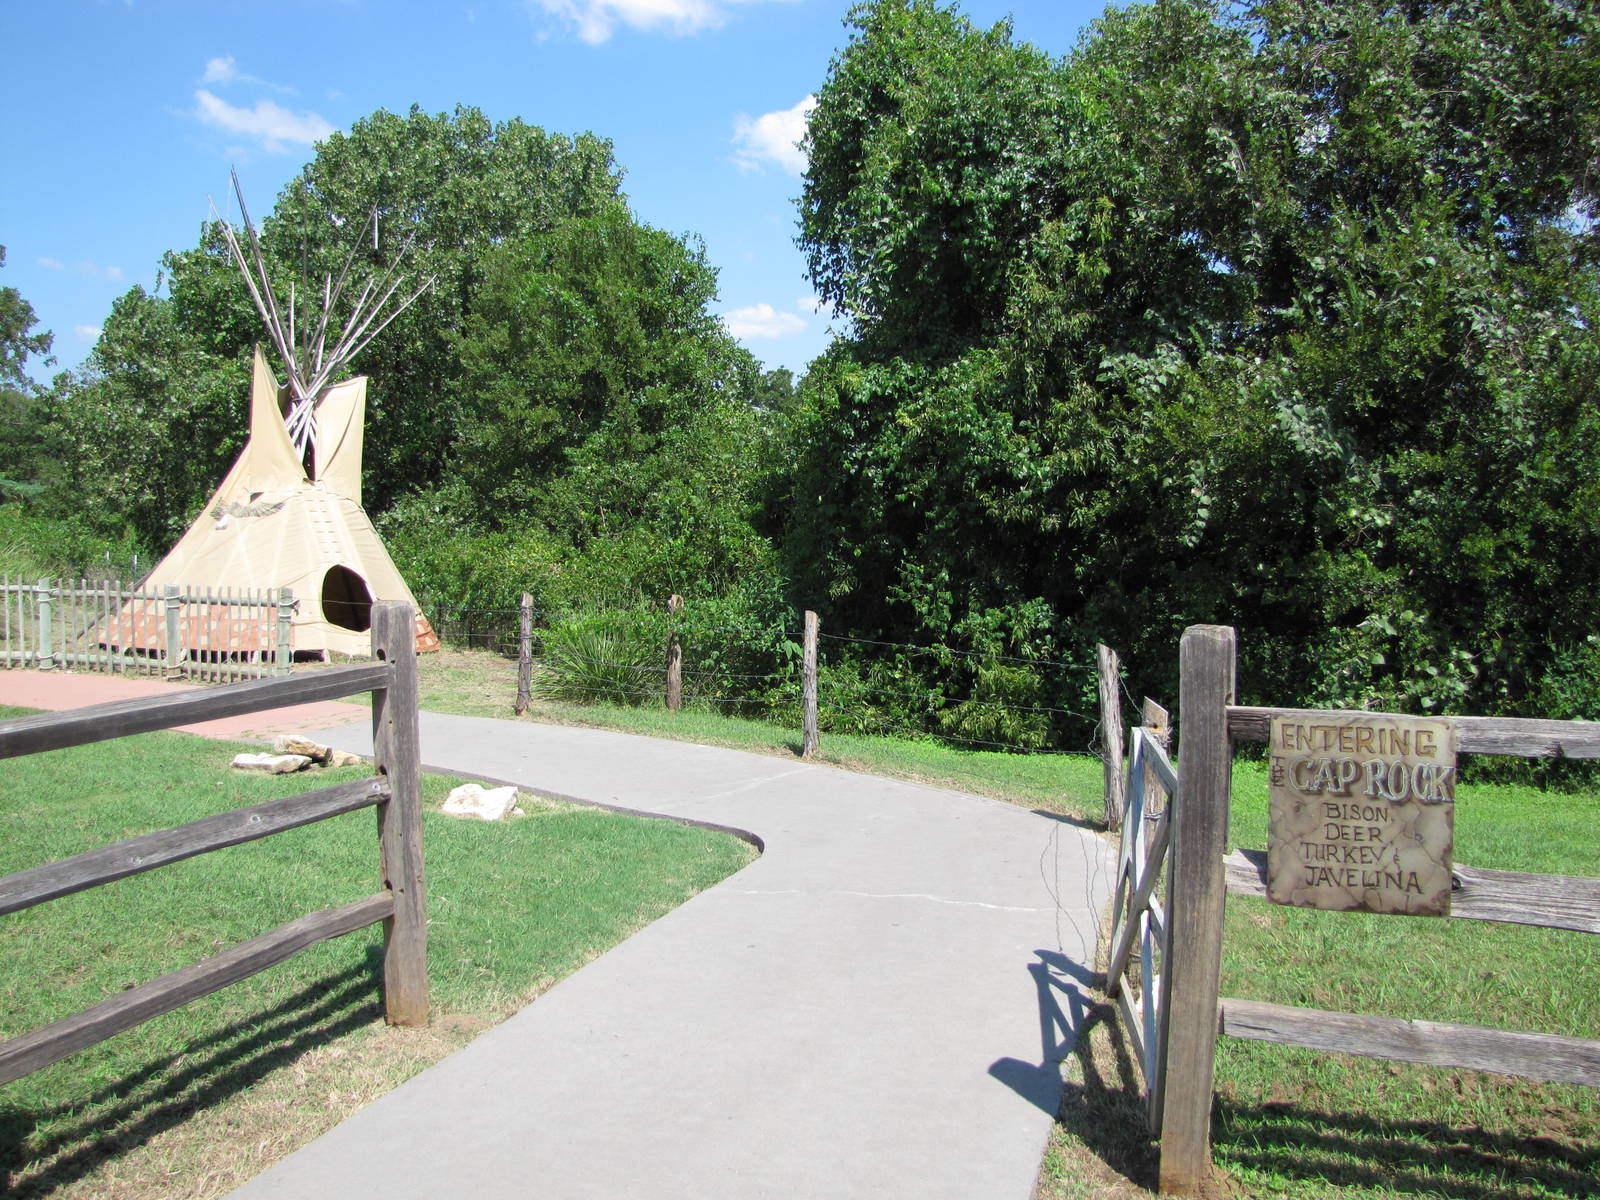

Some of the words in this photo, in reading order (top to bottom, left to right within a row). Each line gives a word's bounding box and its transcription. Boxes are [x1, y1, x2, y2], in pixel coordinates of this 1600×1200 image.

[1281, 723, 1437, 758] ENTERING
[1271, 755, 1286, 787] THE
[1288, 756, 1361, 797] CAP
[1361, 758, 1456, 803] ROCK
[1323, 823, 1384, 842] DEER
[1300, 841, 1388, 864] TURKEY
[1304, 866, 1422, 894] JAVELINA
